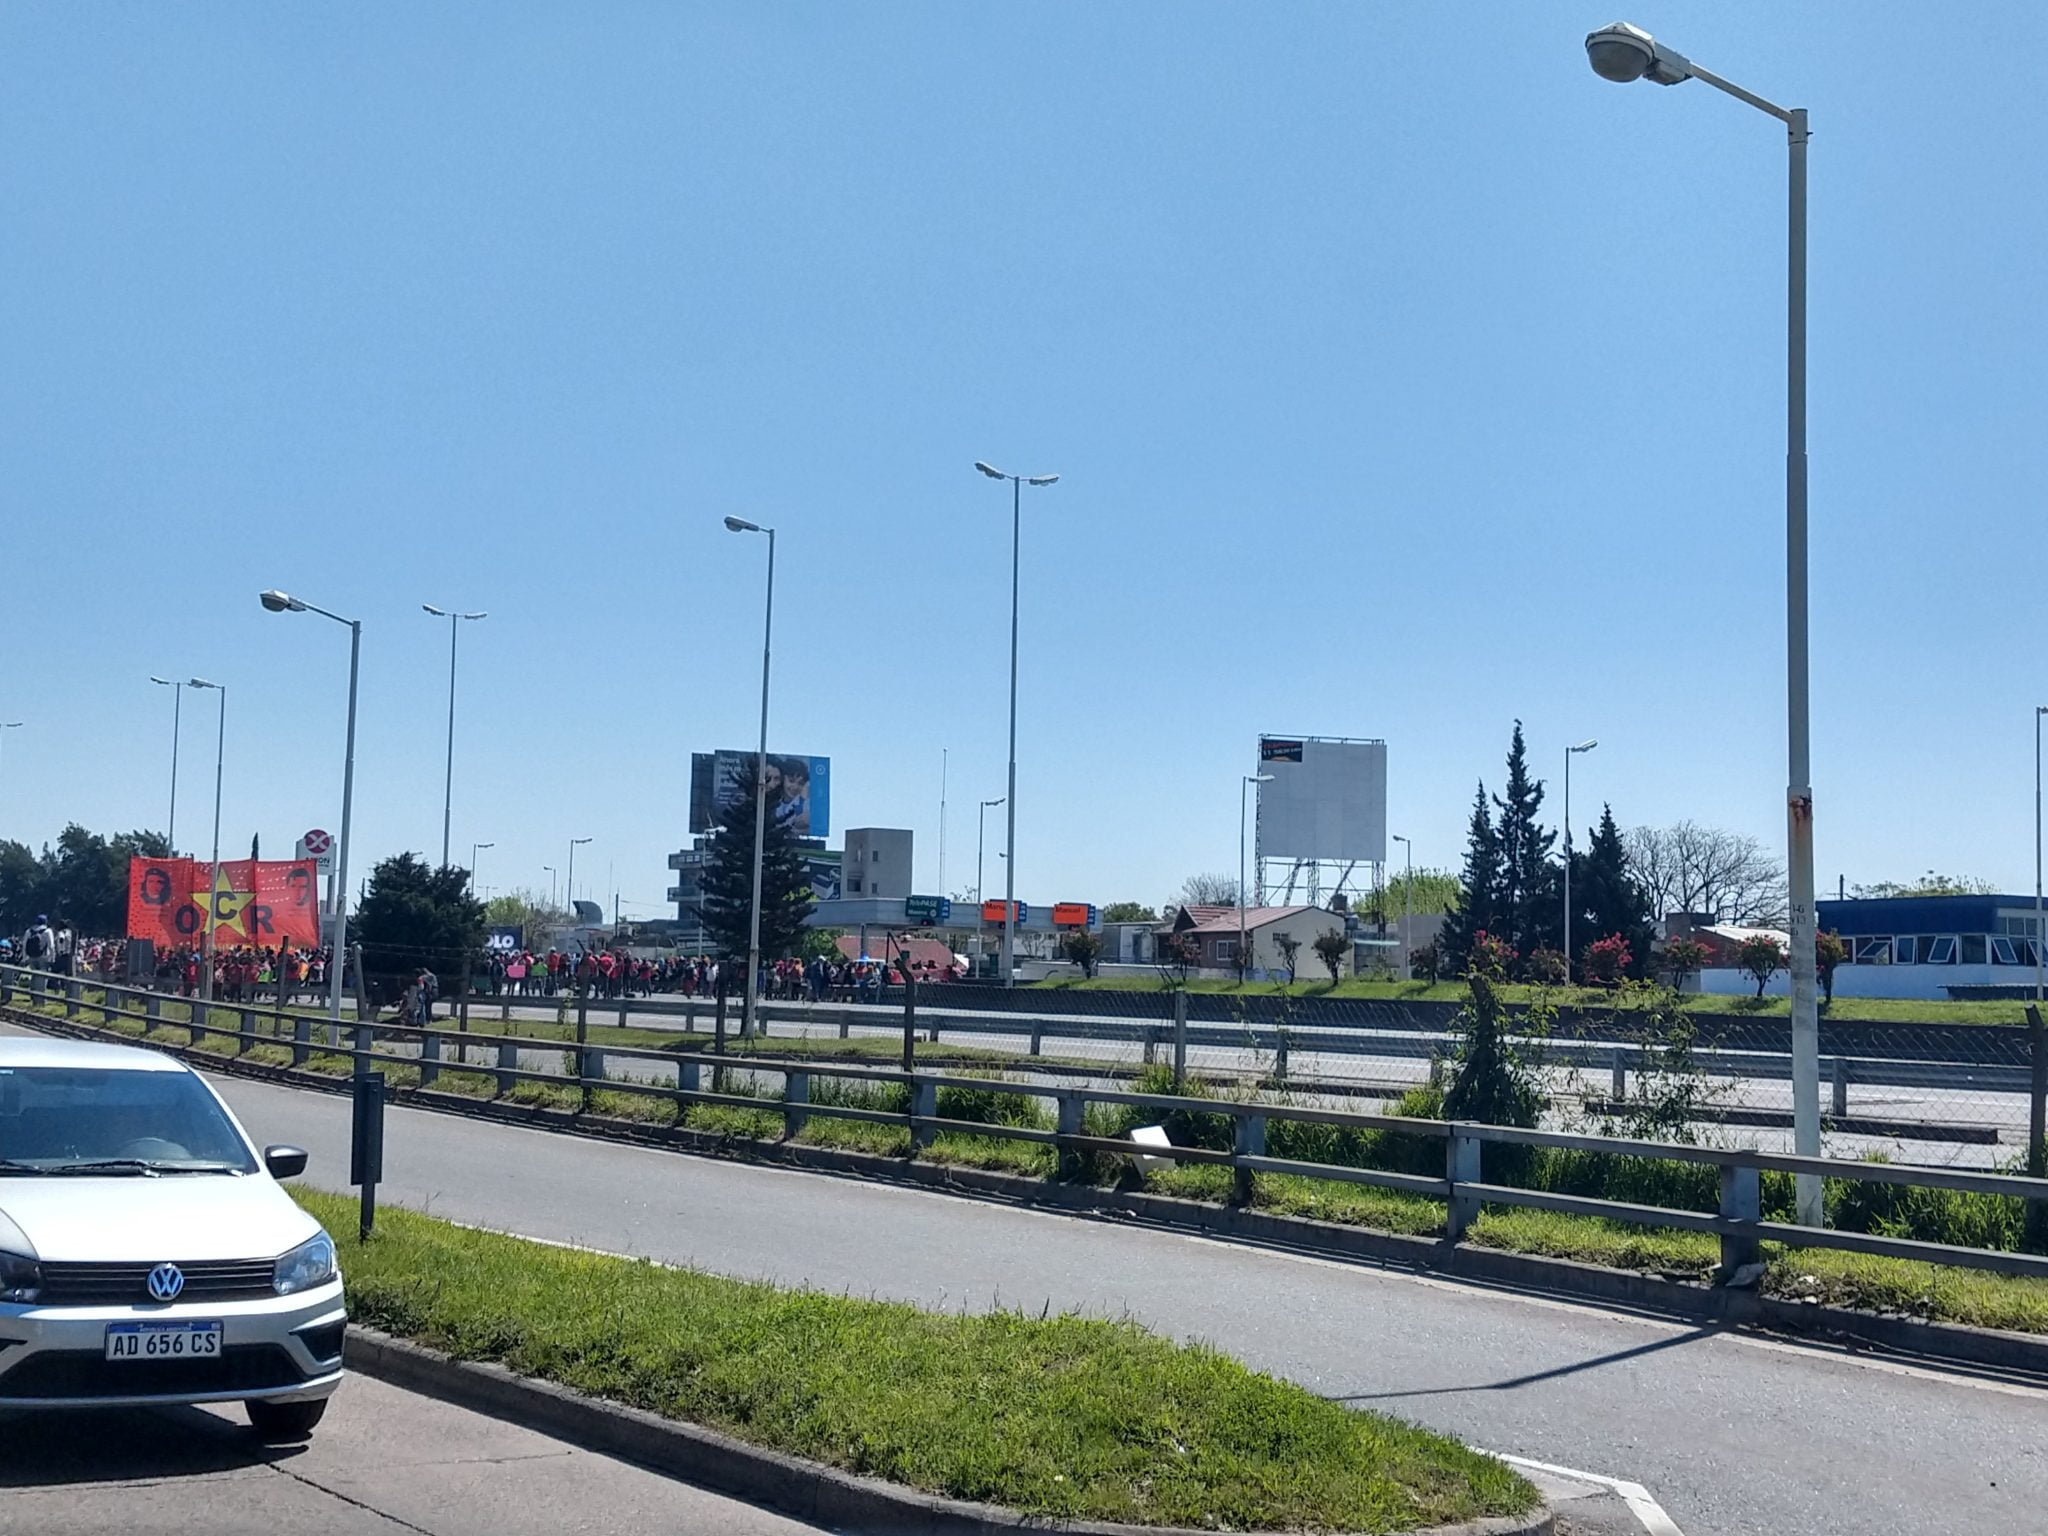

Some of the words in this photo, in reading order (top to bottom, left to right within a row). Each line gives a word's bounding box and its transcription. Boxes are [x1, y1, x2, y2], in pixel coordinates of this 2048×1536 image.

[1055, 906, 1081, 914] Manual
[113, 1335, 139, 1356] AD
[146, 1334, 184, 1355] 656
[191, 1333, 217, 1354] CS
